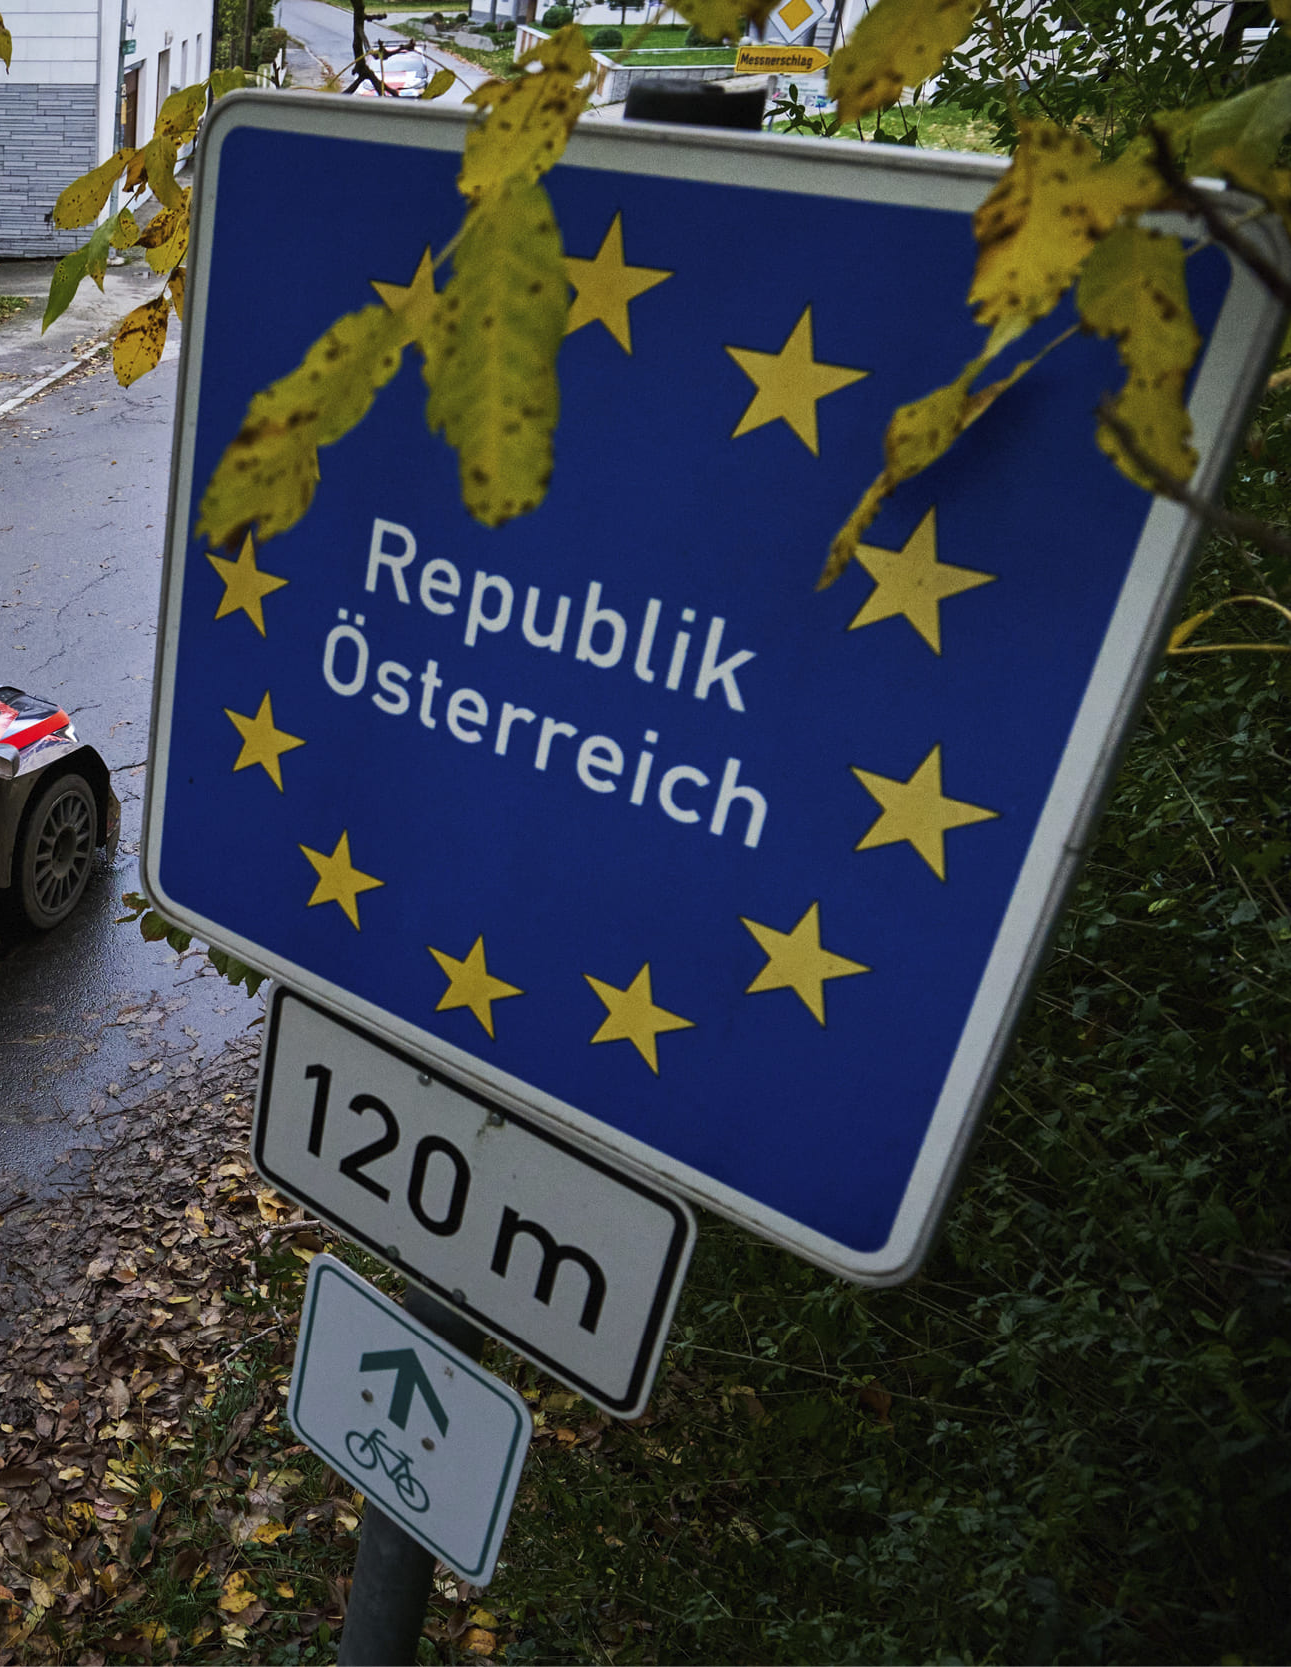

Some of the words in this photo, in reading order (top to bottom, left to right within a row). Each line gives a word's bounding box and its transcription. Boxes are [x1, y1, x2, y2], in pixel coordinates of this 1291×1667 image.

[740, 53, 813, 69] Messnerschlag
[364, 517, 757, 713] Republik
[322, 607, 768, 848] Österreich
[303, 1063, 472, 1237] 120
[490, 1205, 608, 1336] m
